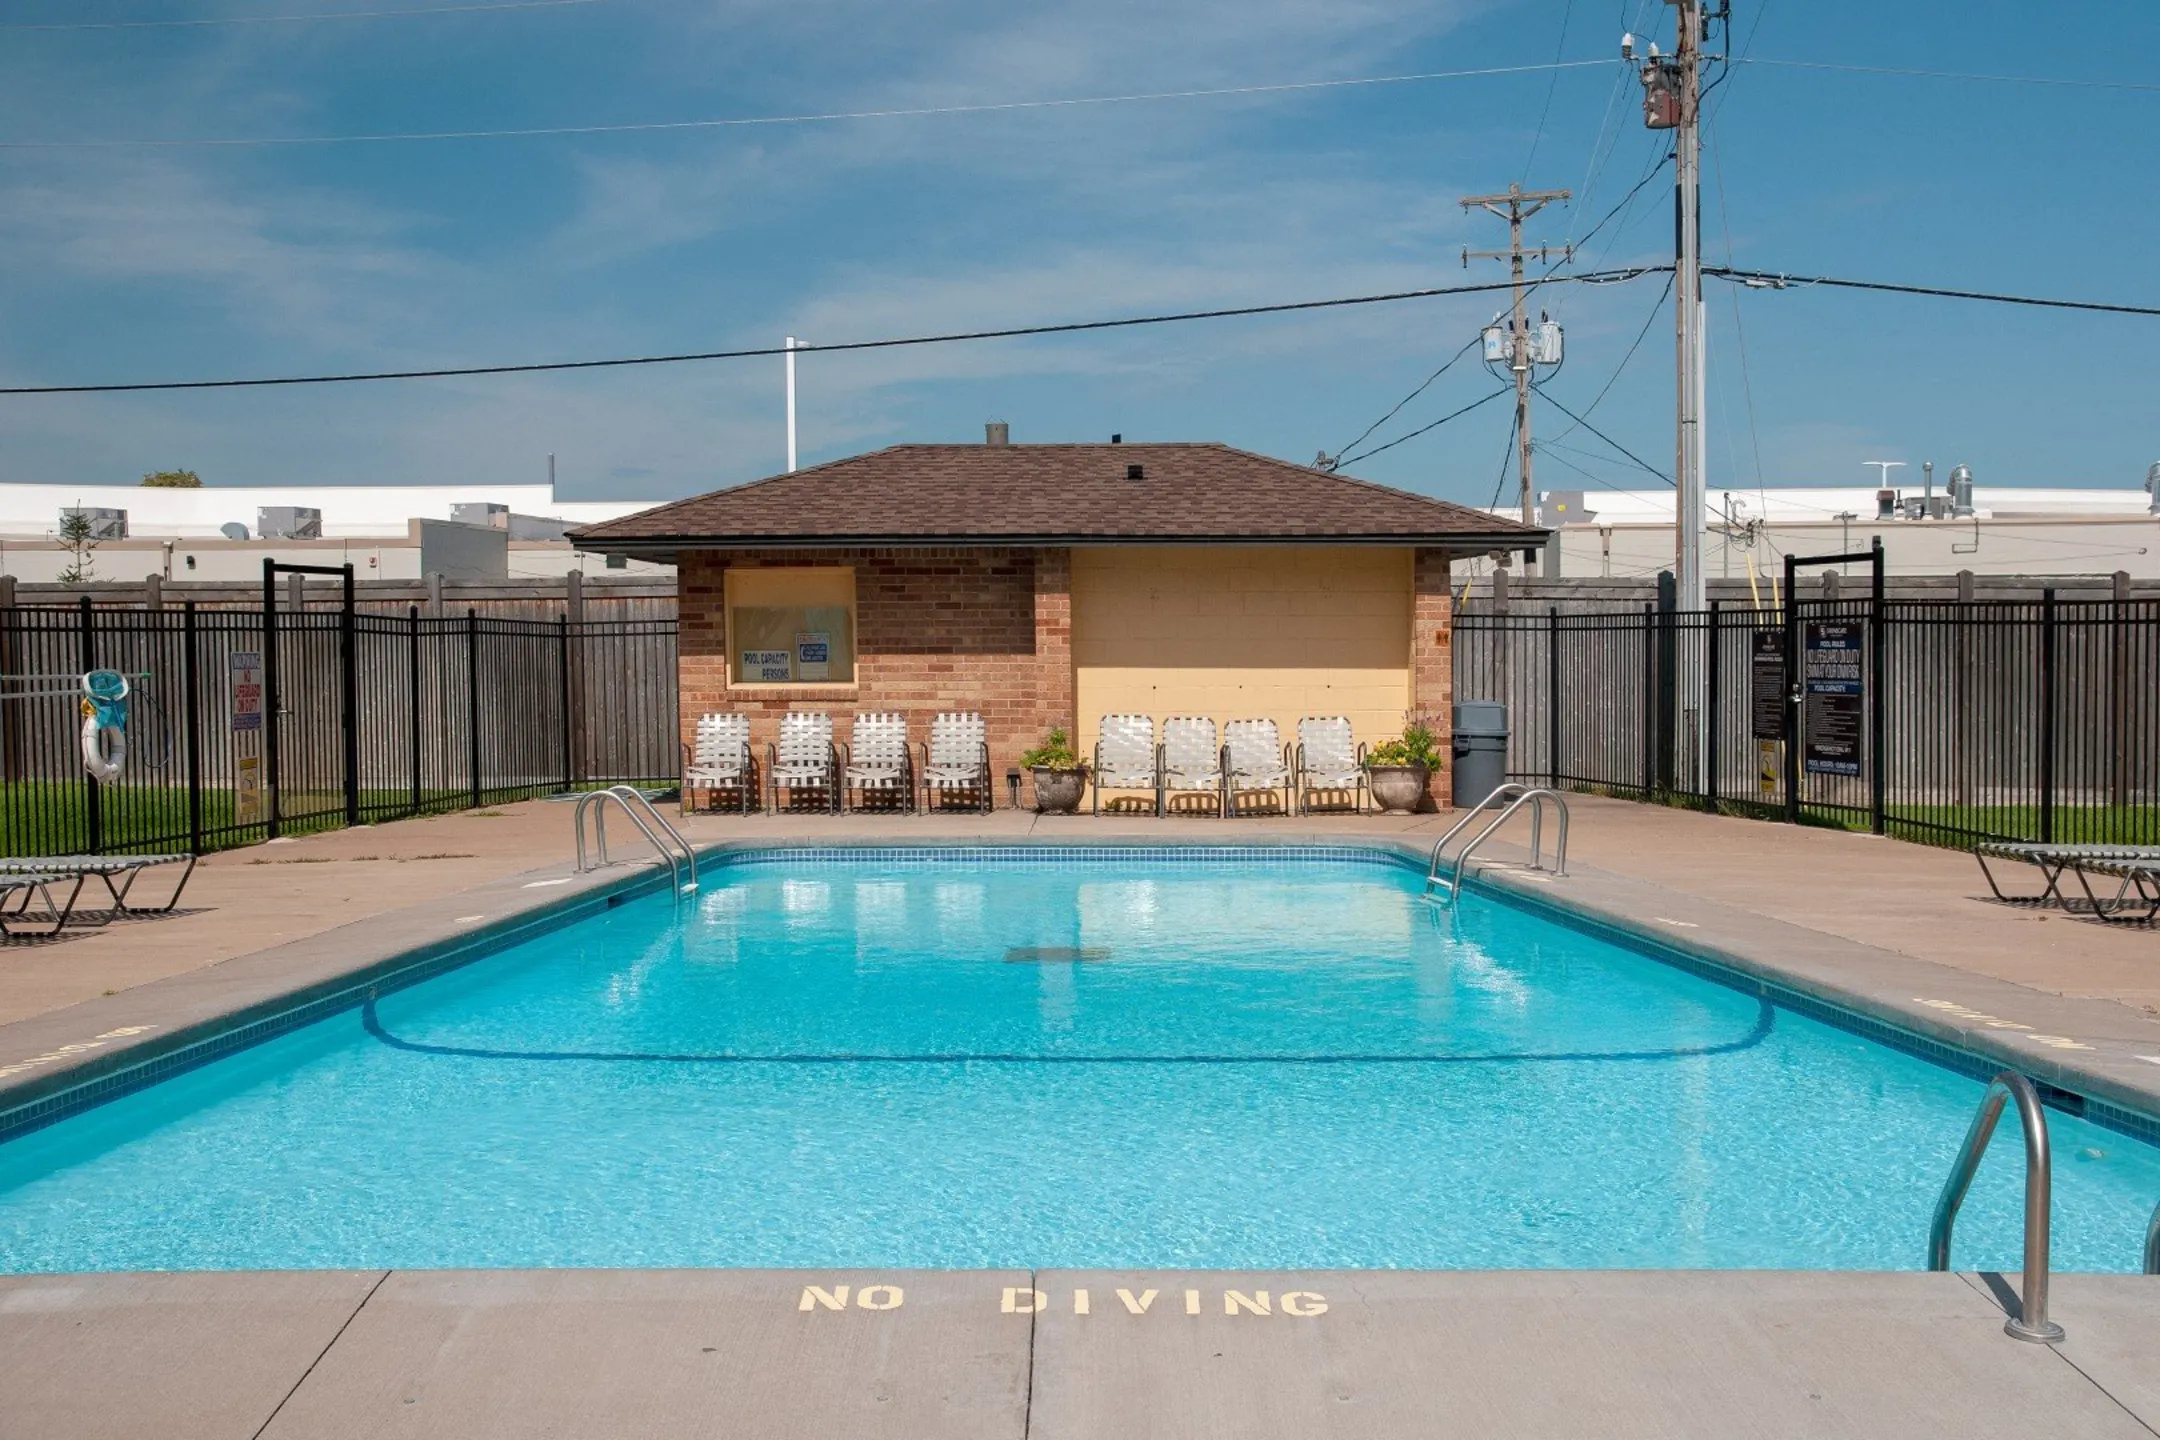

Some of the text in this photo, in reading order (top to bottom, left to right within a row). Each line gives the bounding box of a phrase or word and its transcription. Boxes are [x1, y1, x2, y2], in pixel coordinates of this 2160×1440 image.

[744, 652, 760, 665] POOL
[761, 652, 789, 665] CAPACITY
[762, 668, 789, 680] PERSONS
[799, 1285, 1329, 1316] NO DIVING
